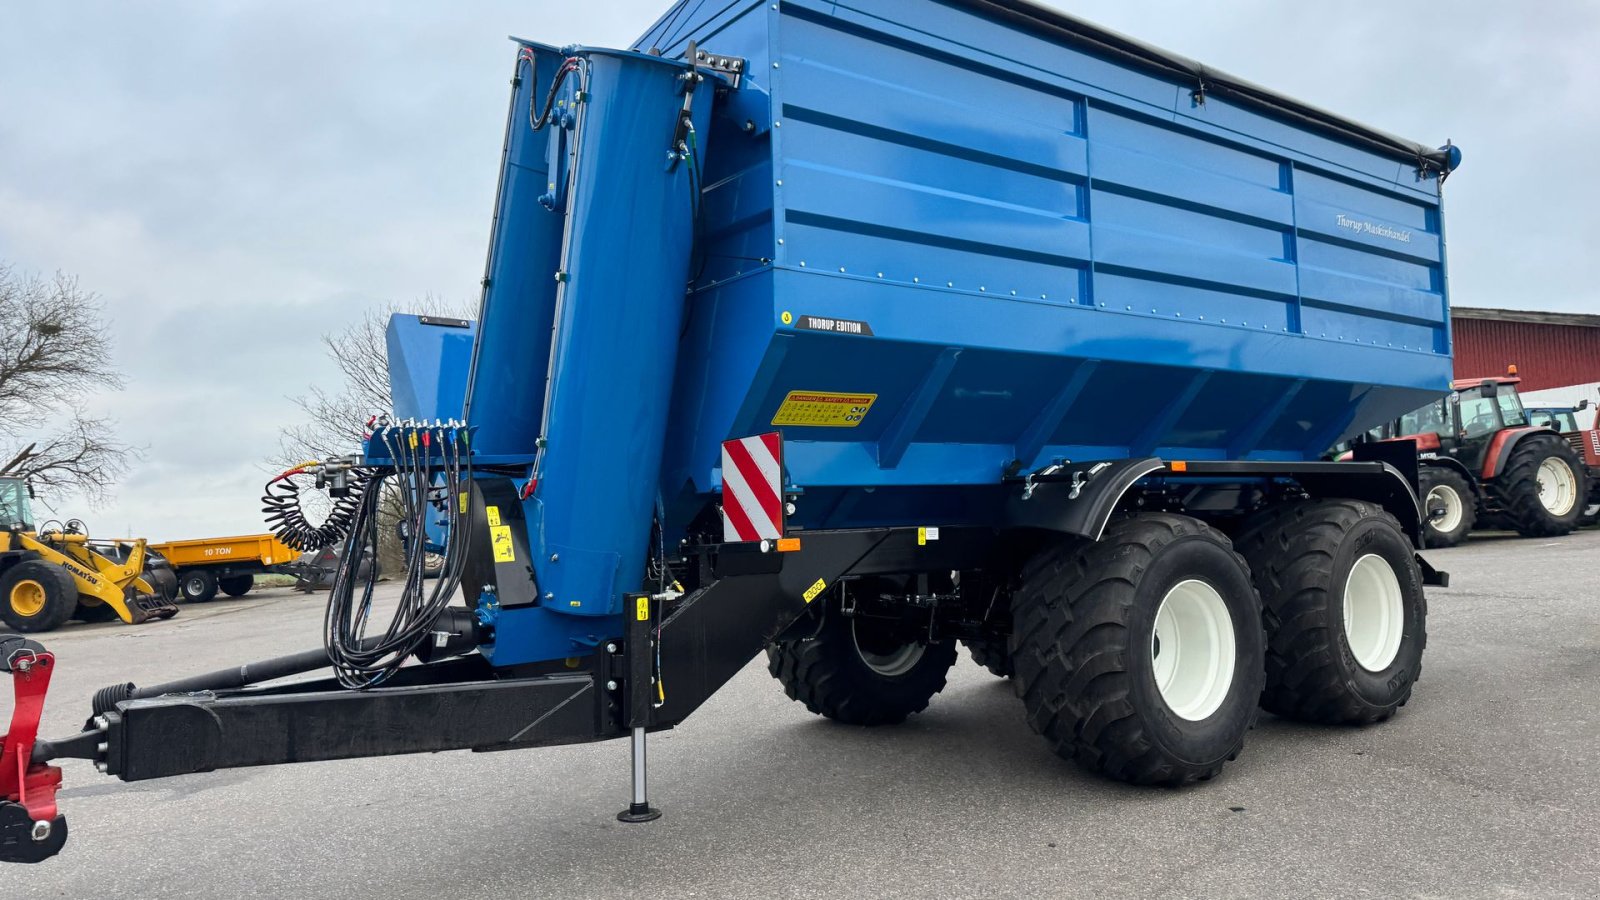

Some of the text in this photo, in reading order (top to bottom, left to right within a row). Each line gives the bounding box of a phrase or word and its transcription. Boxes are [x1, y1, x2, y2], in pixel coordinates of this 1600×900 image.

[1336, 214, 1411, 242] Thorup Maskinhandel
[808, 317, 862, 333] THORUP EDITION
[205, 547, 232, 556] 10 TON
[62, 561, 98, 585] KOMATSU
